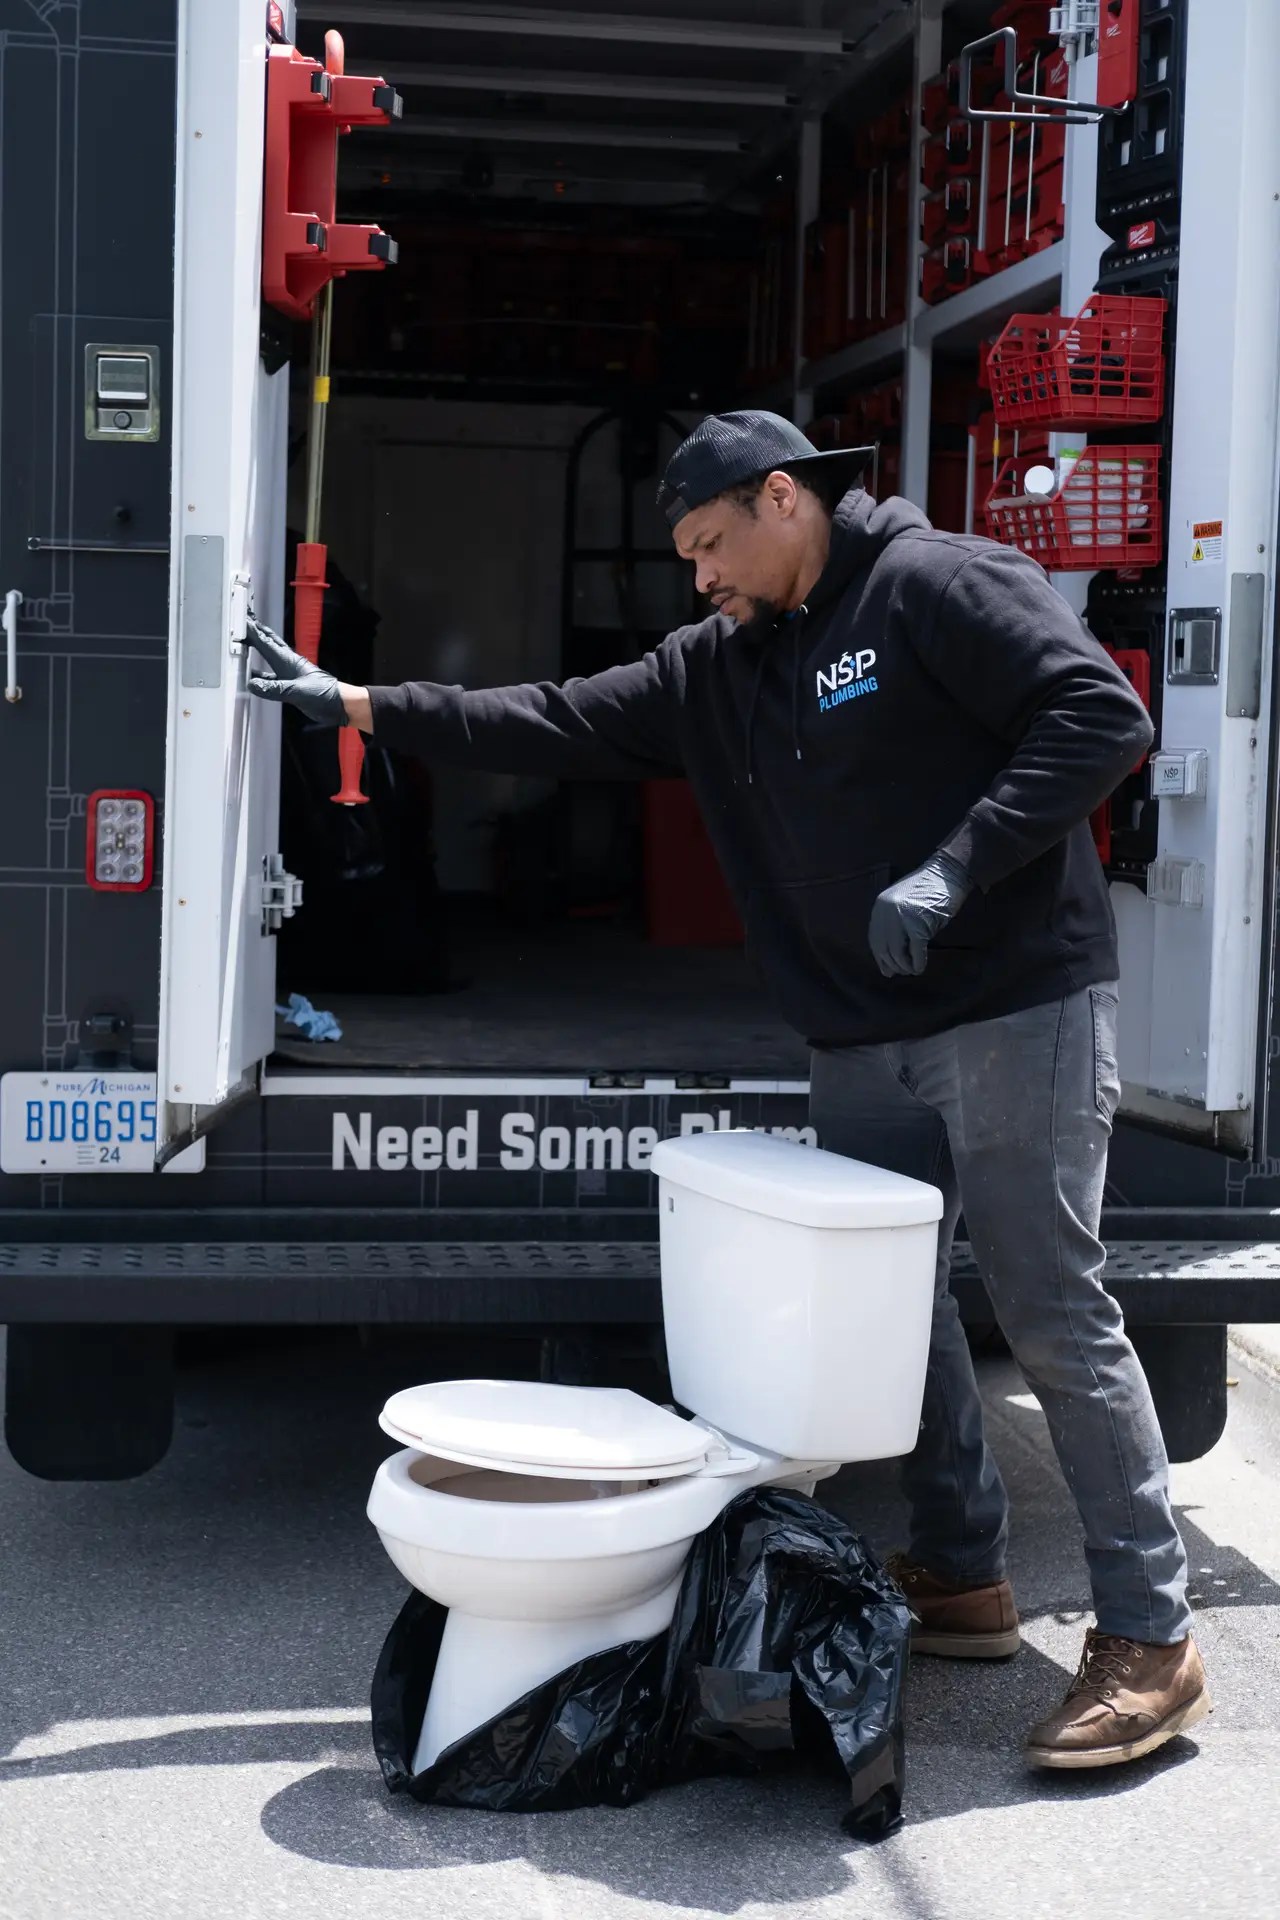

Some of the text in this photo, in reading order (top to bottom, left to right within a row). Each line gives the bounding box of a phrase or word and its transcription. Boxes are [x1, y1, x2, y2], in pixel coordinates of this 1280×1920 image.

[816, 648, 877, 698] NSP
[819, 676, 878, 713] PLUMBING
[1164, 767, 1179, 779] NSP
[56, 1077, 151, 1097] PURE MICHIGAN
[331, 1109, 479, 1171] Need
[499, 1112, 659, 1171] Some
[99, 1147, 121, 1163] 24
